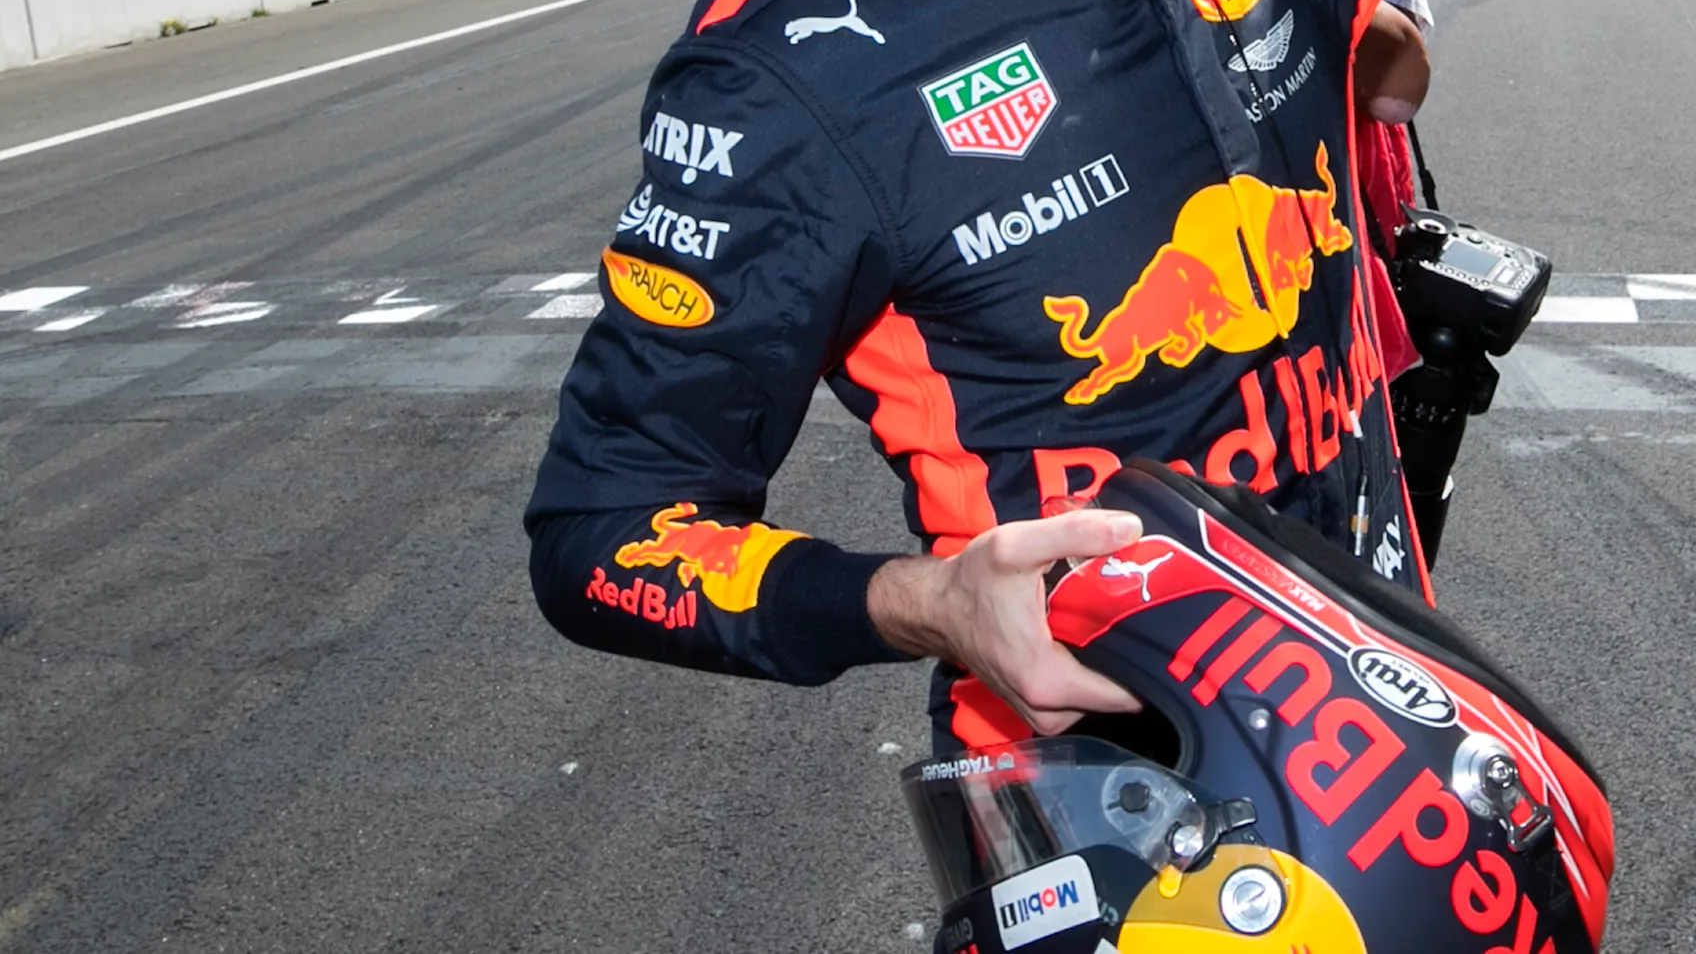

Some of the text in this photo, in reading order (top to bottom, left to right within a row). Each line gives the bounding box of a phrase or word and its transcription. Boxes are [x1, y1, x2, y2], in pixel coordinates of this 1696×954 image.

[935, 53, 1031, 115] TAG
[1284, 47, 1317, 96] MARTIN
[642, 111, 745, 185] ITRIX
[949, 87, 1050, 150] HEUER
[639, 202, 730, 260] AT&T
[952, 180, 1088, 266] Mobil
[627, 261, 699, 320] RAUCH
[1033, 369, 1279, 519] Rd
[1359, 657, 1451, 711] Arai
[1018, 880, 1080, 922] Mobil
